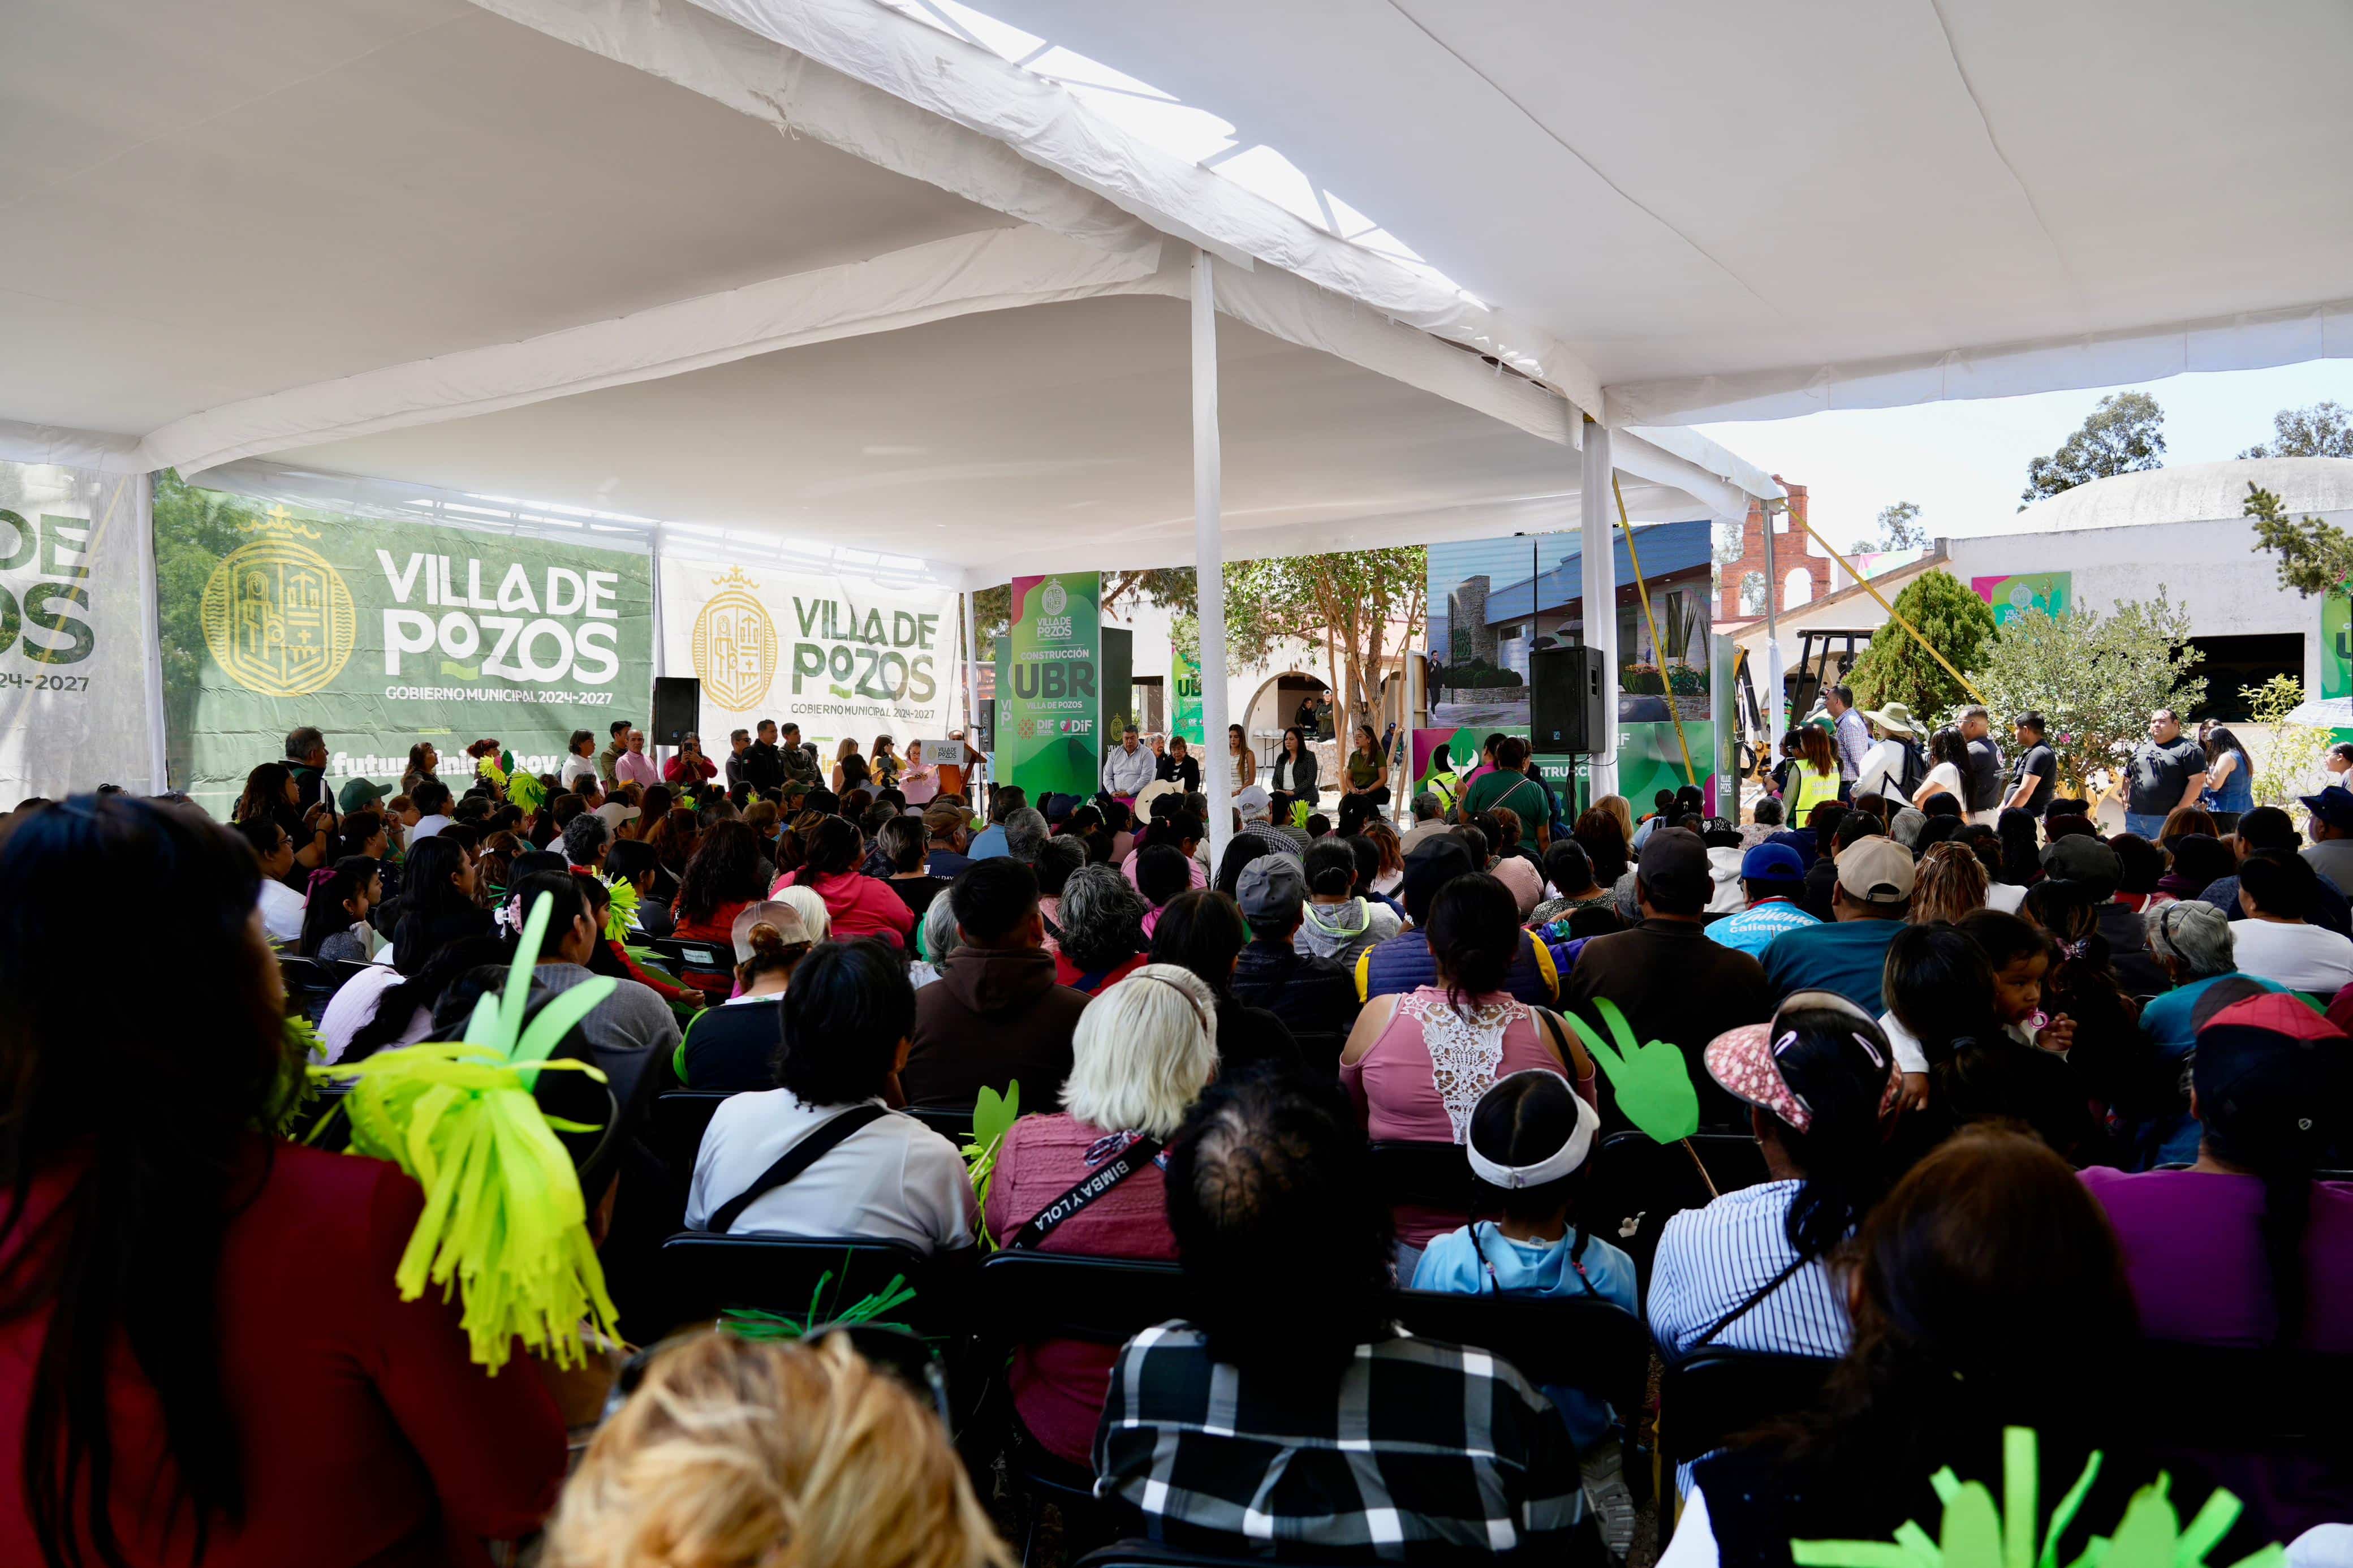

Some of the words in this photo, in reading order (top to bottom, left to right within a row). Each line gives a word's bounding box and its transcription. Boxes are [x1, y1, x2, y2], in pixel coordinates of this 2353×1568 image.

[376, 549, 540, 613] VILLA
[546, 566, 618, 619] DE
[792, 597, 889, 647] VILLA
[894, 611, 939, 650] DE
[1037, 617, 1059, 626] VILLA
[1060, 617, 1071, 625] DE
[1037, 625, 1072, 637] POZOS
[383, 609, 619, 684] POZOS
[1020, 647, 1089, 660] CONSTRUCCIÓN
[792, 643, 936, 703] POZOS
[1015, 661, 1096, 699] UBR
[385, 686, 465, 701] GOBIERNO
[466, 688, 537, 703] MUNICIPAL
[538, 691, 613, 704] 2024-2027
[791, 703, 843, 714] GOBIERNO
[844, 705, 891, 717] MUNICIPAL
[893, 708, 935, 719] 2024-2027
[1037, 720, 1054, 729] DIF
[332, 752, 410, 777] futur
[1730, 923, 1792, 933] caliente
[1080, 1160, 1130, 1197] BIMBA
[1072, 1193, 1084, 1207] Y
[1035, 1199, 1072, 1231] LOLA
